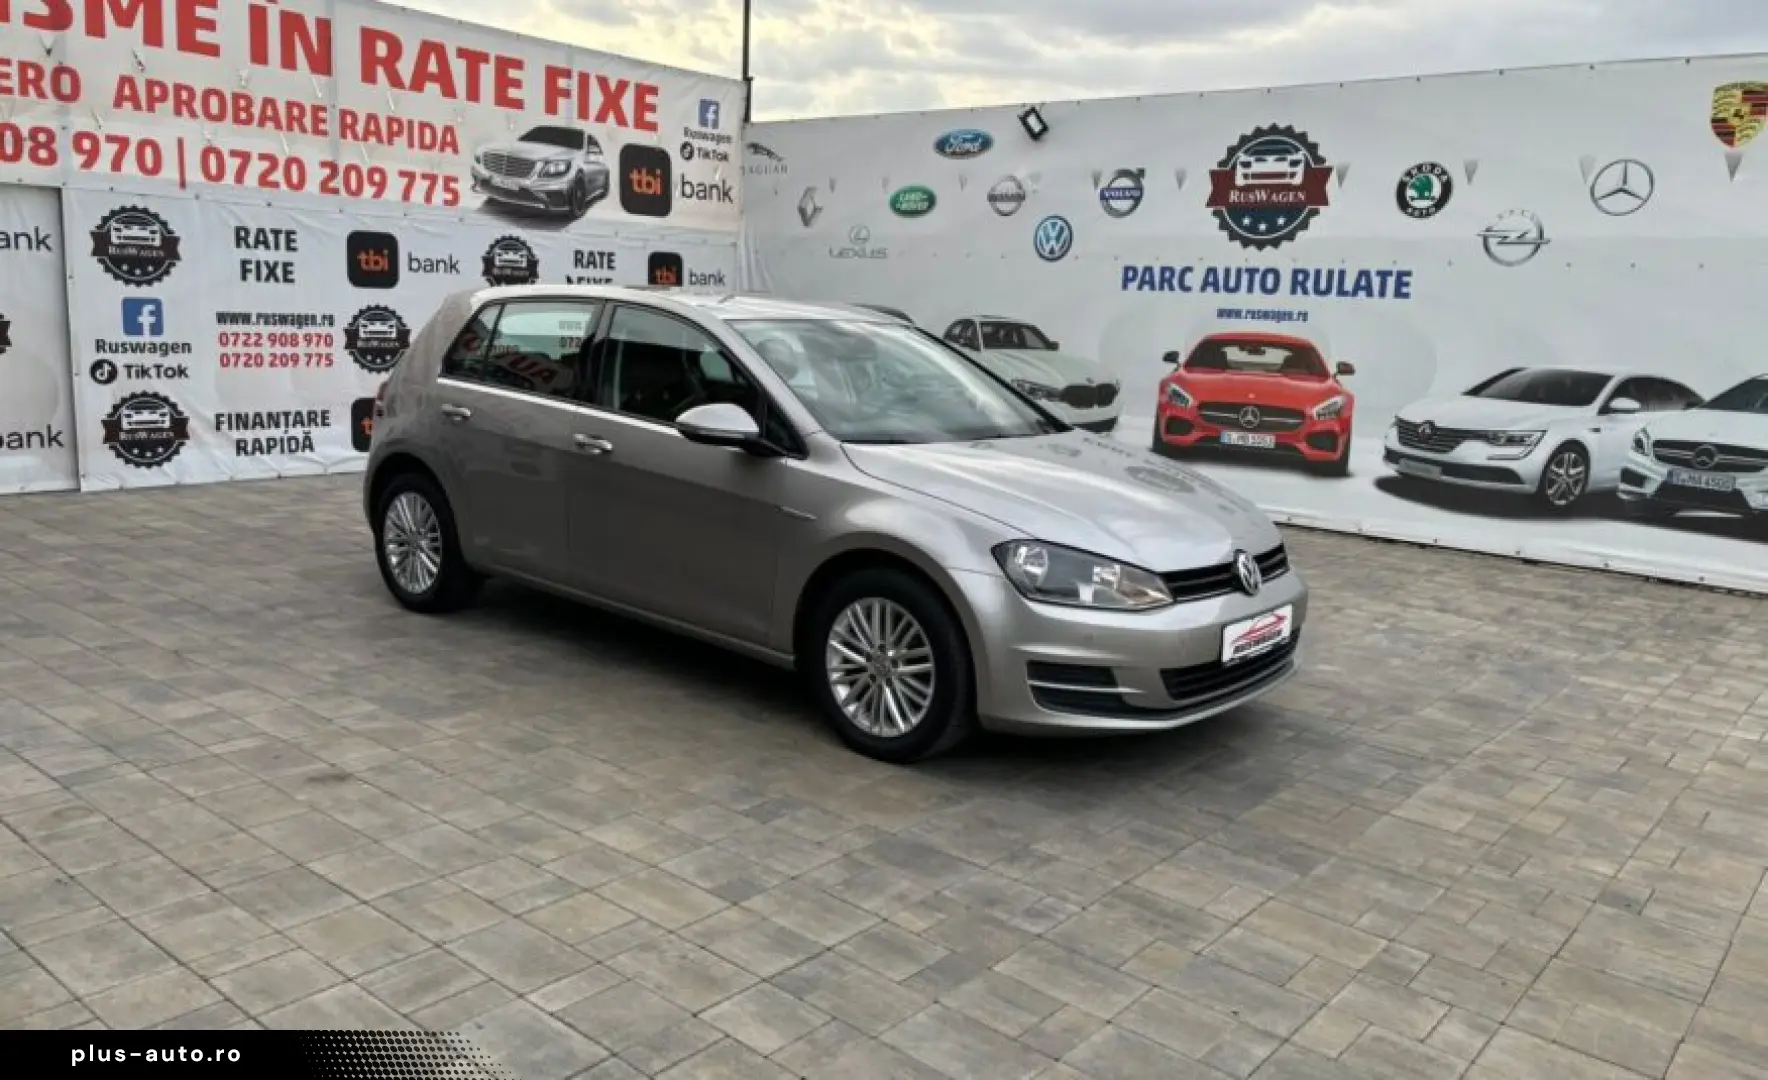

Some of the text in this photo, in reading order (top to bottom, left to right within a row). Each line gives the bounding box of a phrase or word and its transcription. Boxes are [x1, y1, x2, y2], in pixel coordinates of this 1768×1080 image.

[360, 26, 524, 111] RATE
[544, 65, 660, 133] FIXE
[113, 75, 329, 138] APROBARE
[339, 108, 459, 155] RAPIDA
[72, 131, 162, 176] 970
[201, 146, 307, 192] 0720
[319, 160, 388, 199] 209
[397, 170, 460, 207] 775
[629, 168, 733, 204] tbi bank
[234, 226, 298, 252] RATE
[240, 259, 295, 283] FIXE
[357, 249, 461, 274] tbi bank
[574, 250, 616, 270] RATE
[689, 268, 725, 286] bank
[1121, 265, 1412, 299] PARC AUTO RULATE
[216, 311, 335, 329] www.ruswagen.ro
[95, 339, 192, 357] Ruswagen
[219, 332, 334, 348] 0722 908 970
[123, 363, 189, 380] TikTok
[220, 353, 334, 368] 0720 209 775
[0, 424, 64, 449] ank
[236, 431, 315, 456] RAPIDĂ
